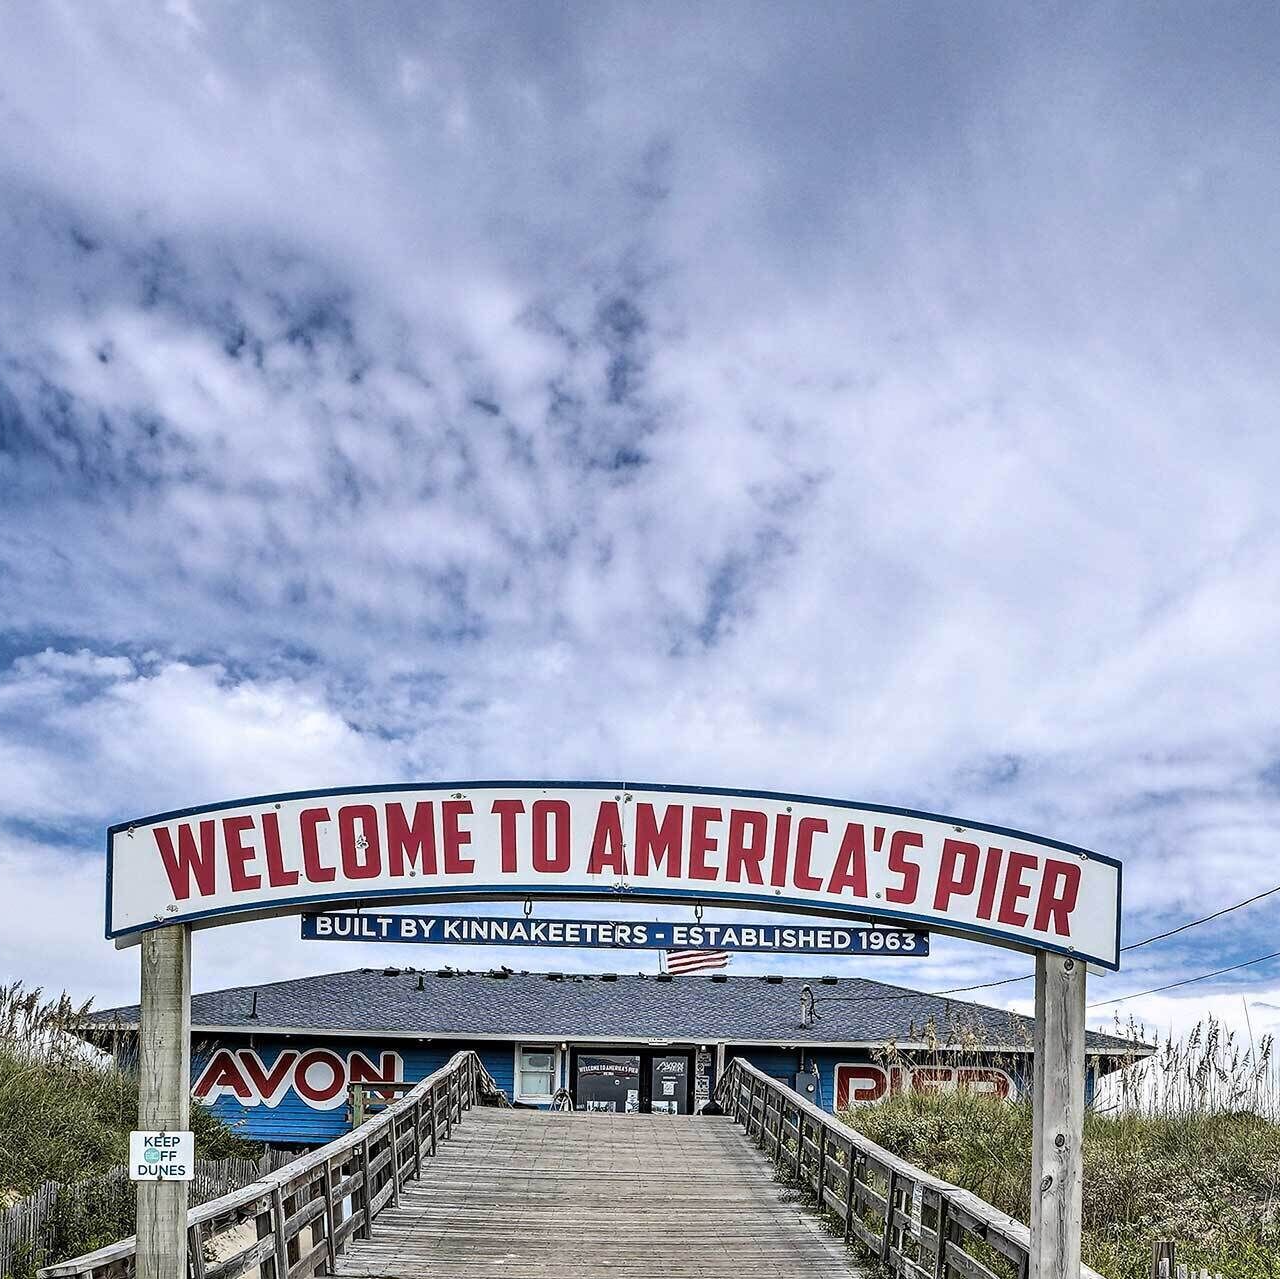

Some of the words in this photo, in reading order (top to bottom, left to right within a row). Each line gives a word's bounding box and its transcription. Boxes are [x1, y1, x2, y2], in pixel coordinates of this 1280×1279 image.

[152, 799, 476, 901] WELCOME
[490, 799, 571, 874] TO
[586, 801, 924, 905] AMERICA'S
[933, 837, 1082, 938] PIER
[316, 916, 393, 936] BUILT
[400, 918, 435, 938] BY
[443, 919, 648, 945] KINNAKEETERS
[673, 926, 852, 949] ESTABLISHED
[858, 931, 917, 951] 1963
[192, 1049, 401, 1107] AVON
[144, 1136, 180, 1148] KEEP
[138, 1164, 186, 1176] DUNES
